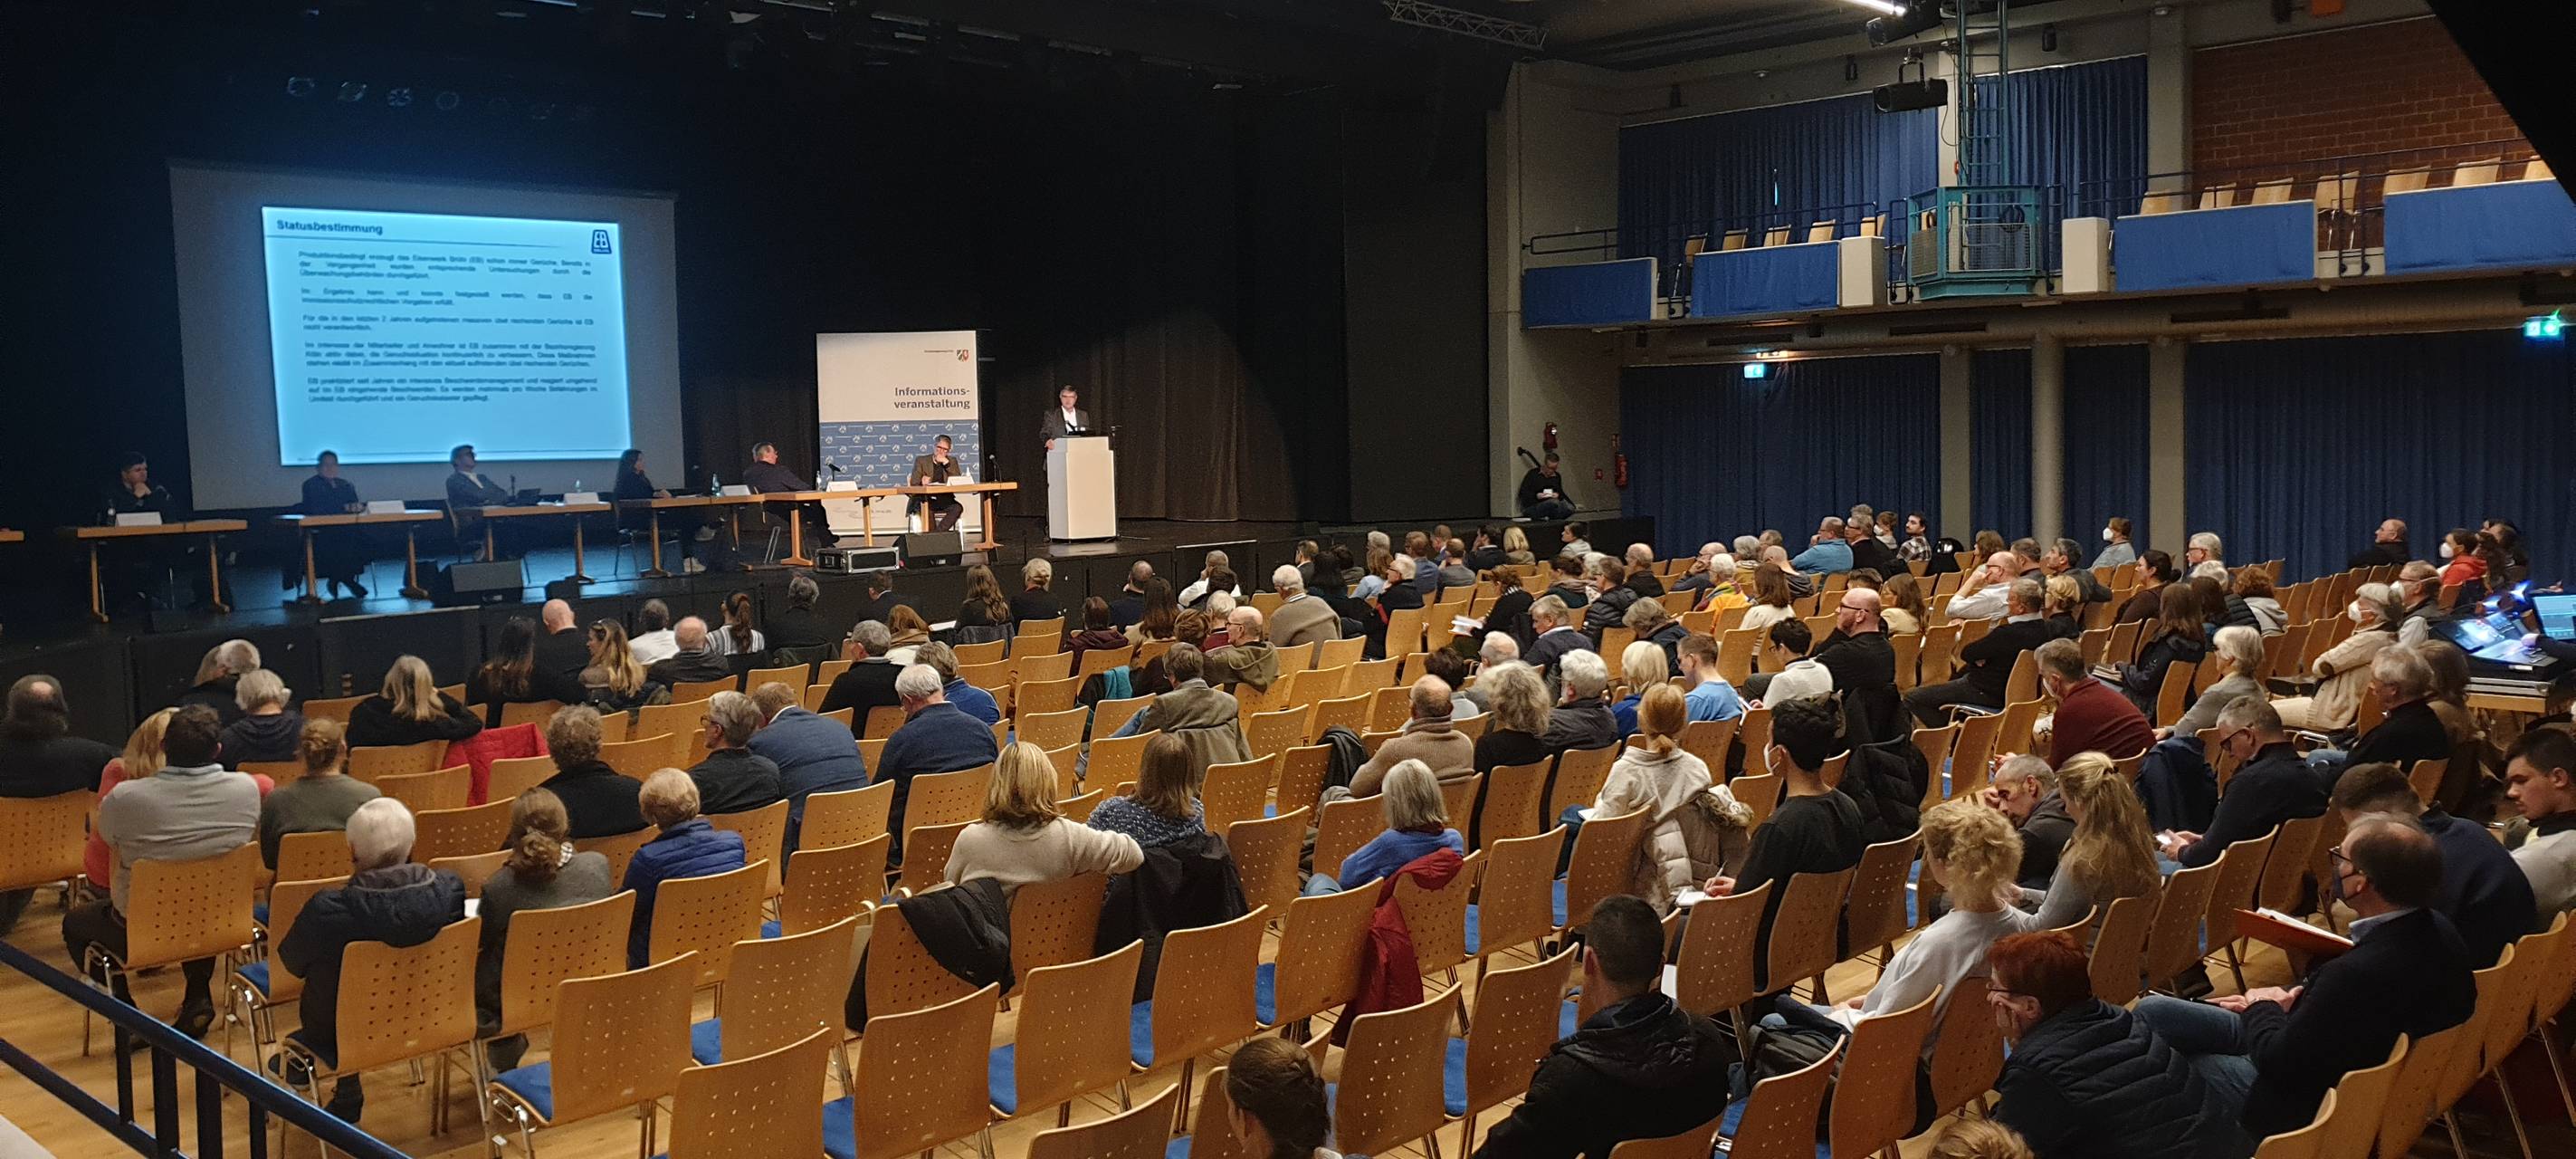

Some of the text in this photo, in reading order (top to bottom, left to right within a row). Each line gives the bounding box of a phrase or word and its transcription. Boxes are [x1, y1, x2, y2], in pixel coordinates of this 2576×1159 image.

[276, 220, 383, 235] Statusbestimmung
[894, 386, 970, 397] Informations-
[893, 399, 970, 409] veranstaltung
